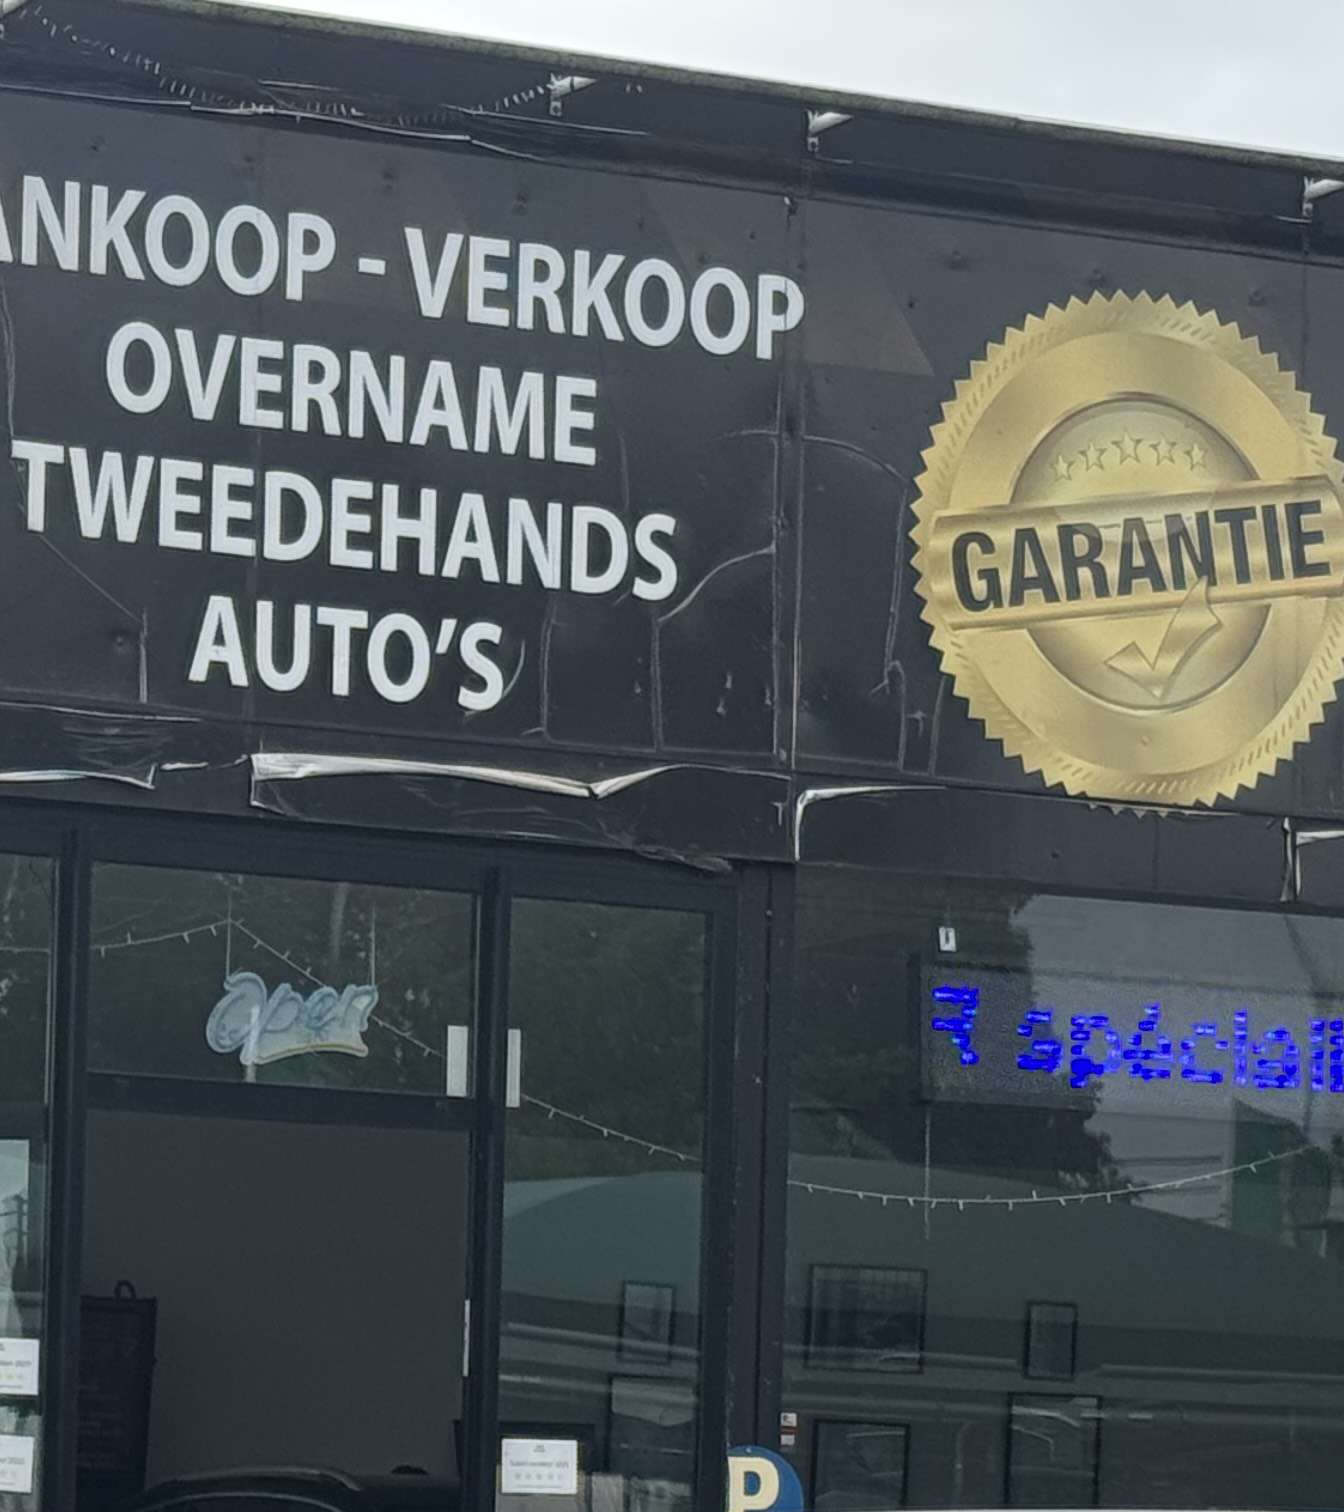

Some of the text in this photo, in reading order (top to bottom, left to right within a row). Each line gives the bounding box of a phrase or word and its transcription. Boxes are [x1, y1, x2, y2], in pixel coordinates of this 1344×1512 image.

[402, 227, 806, 361] VERKOOP
[106, 321, 598, 468] OVERNAME
[10, 438, 679, 602] TWEEDEHANDS
[951, 500, 1332, 613] GARANTIE
[188, 594, 506, 712] AUTO'S
